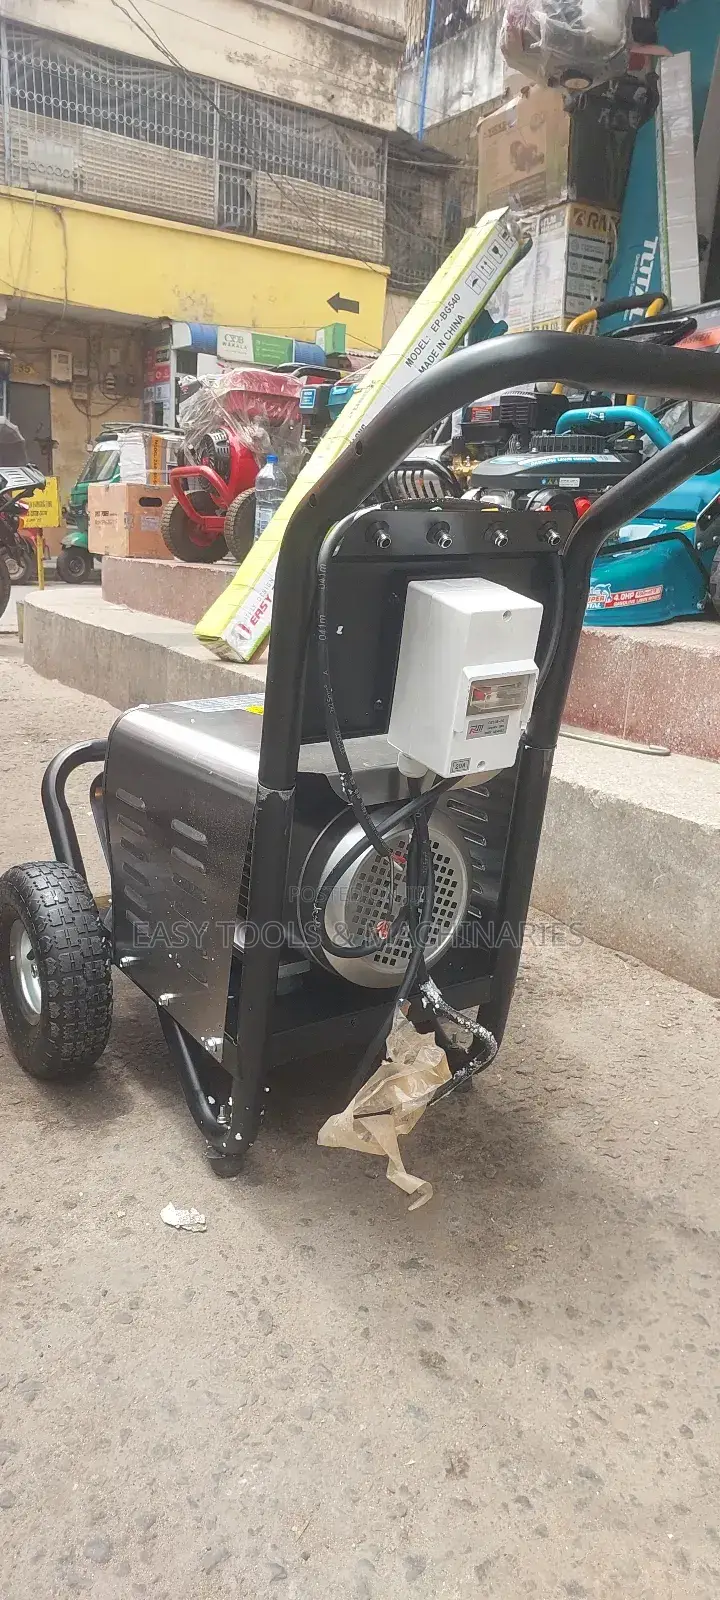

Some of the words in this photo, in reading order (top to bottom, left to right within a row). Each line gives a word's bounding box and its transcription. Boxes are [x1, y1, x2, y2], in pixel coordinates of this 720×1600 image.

[405, 335, 432, 368] MODEL:
[430, 293, 461, 334] EP-BG540
[418, 348, 441, 374] MADE
[438, 339, 447, 352] IN
[444, 314, 466, 341] CHINA
[249, 594, 273, 627] EASY
[318, 614, 327, 641] 041m
